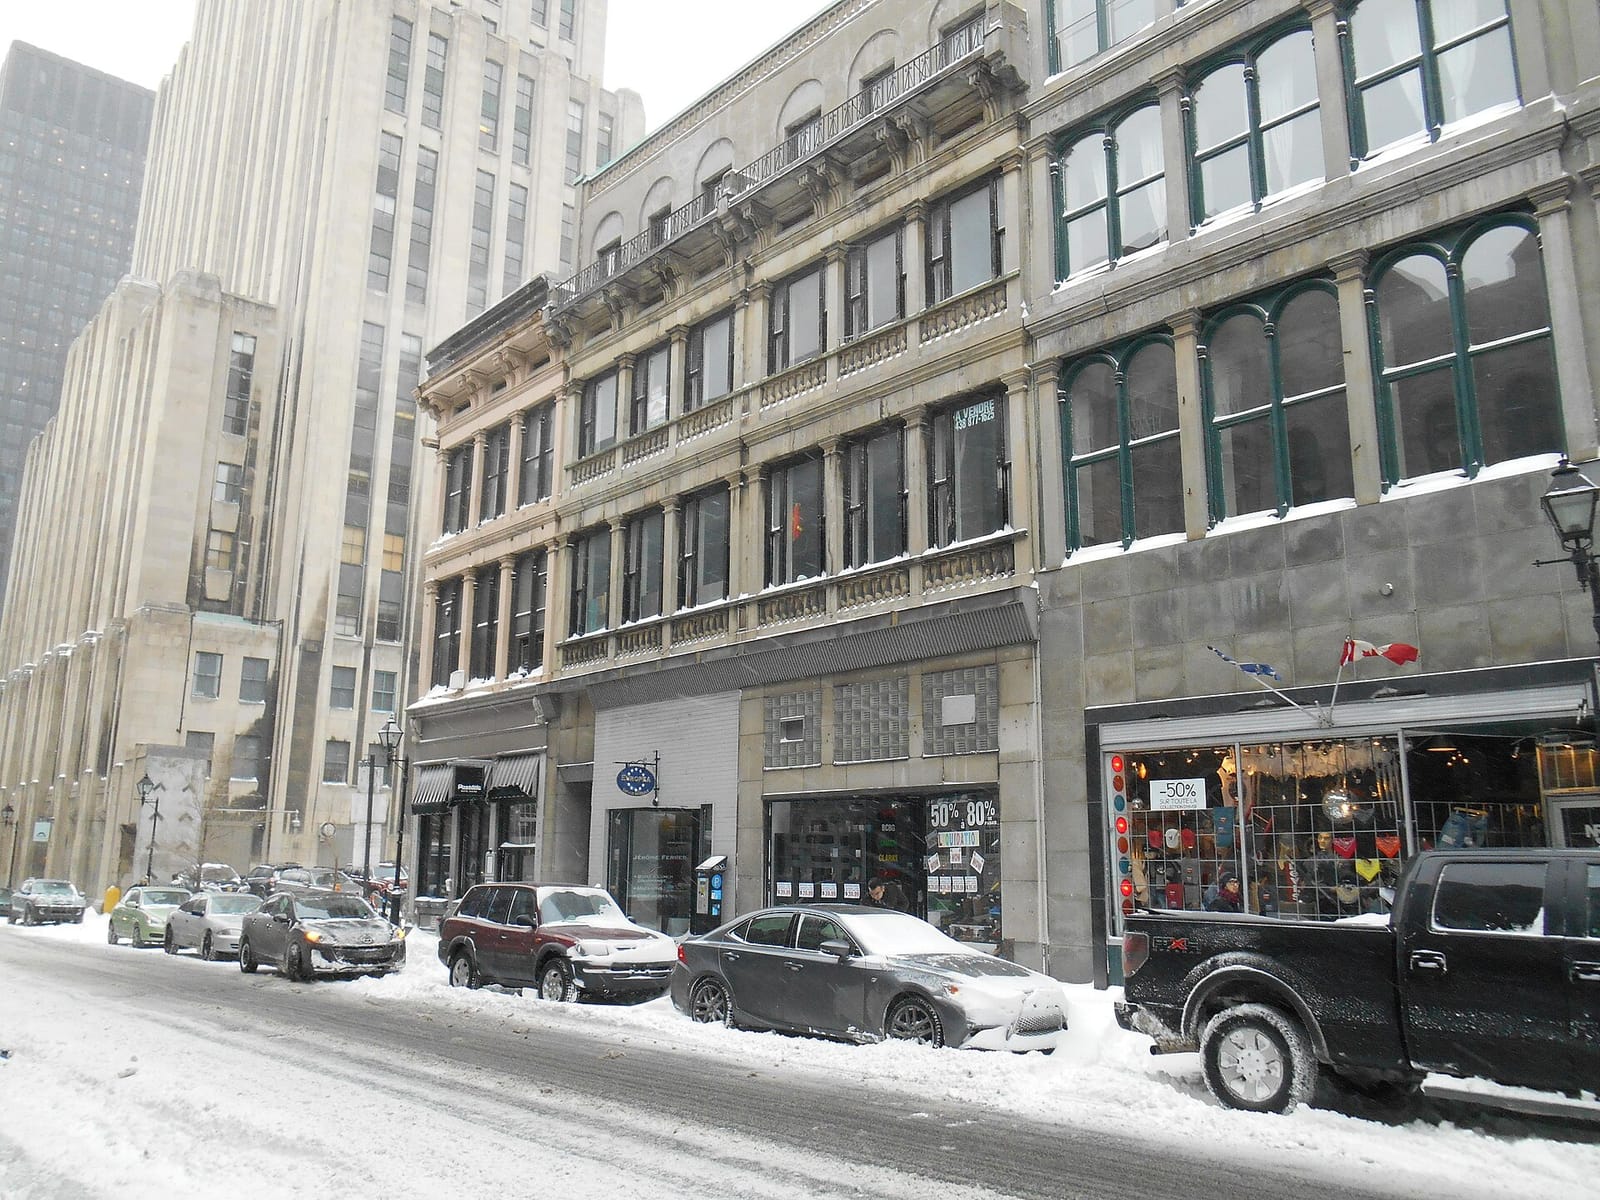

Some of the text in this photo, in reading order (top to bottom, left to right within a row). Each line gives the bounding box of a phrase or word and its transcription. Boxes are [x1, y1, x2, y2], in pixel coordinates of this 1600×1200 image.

[963, 400, 995, 418] VENDRE
[1159, 782, 1197, 798] -50%
[930, 802, 959, 827] 50%
[966, 800, 996, 827] 80%
